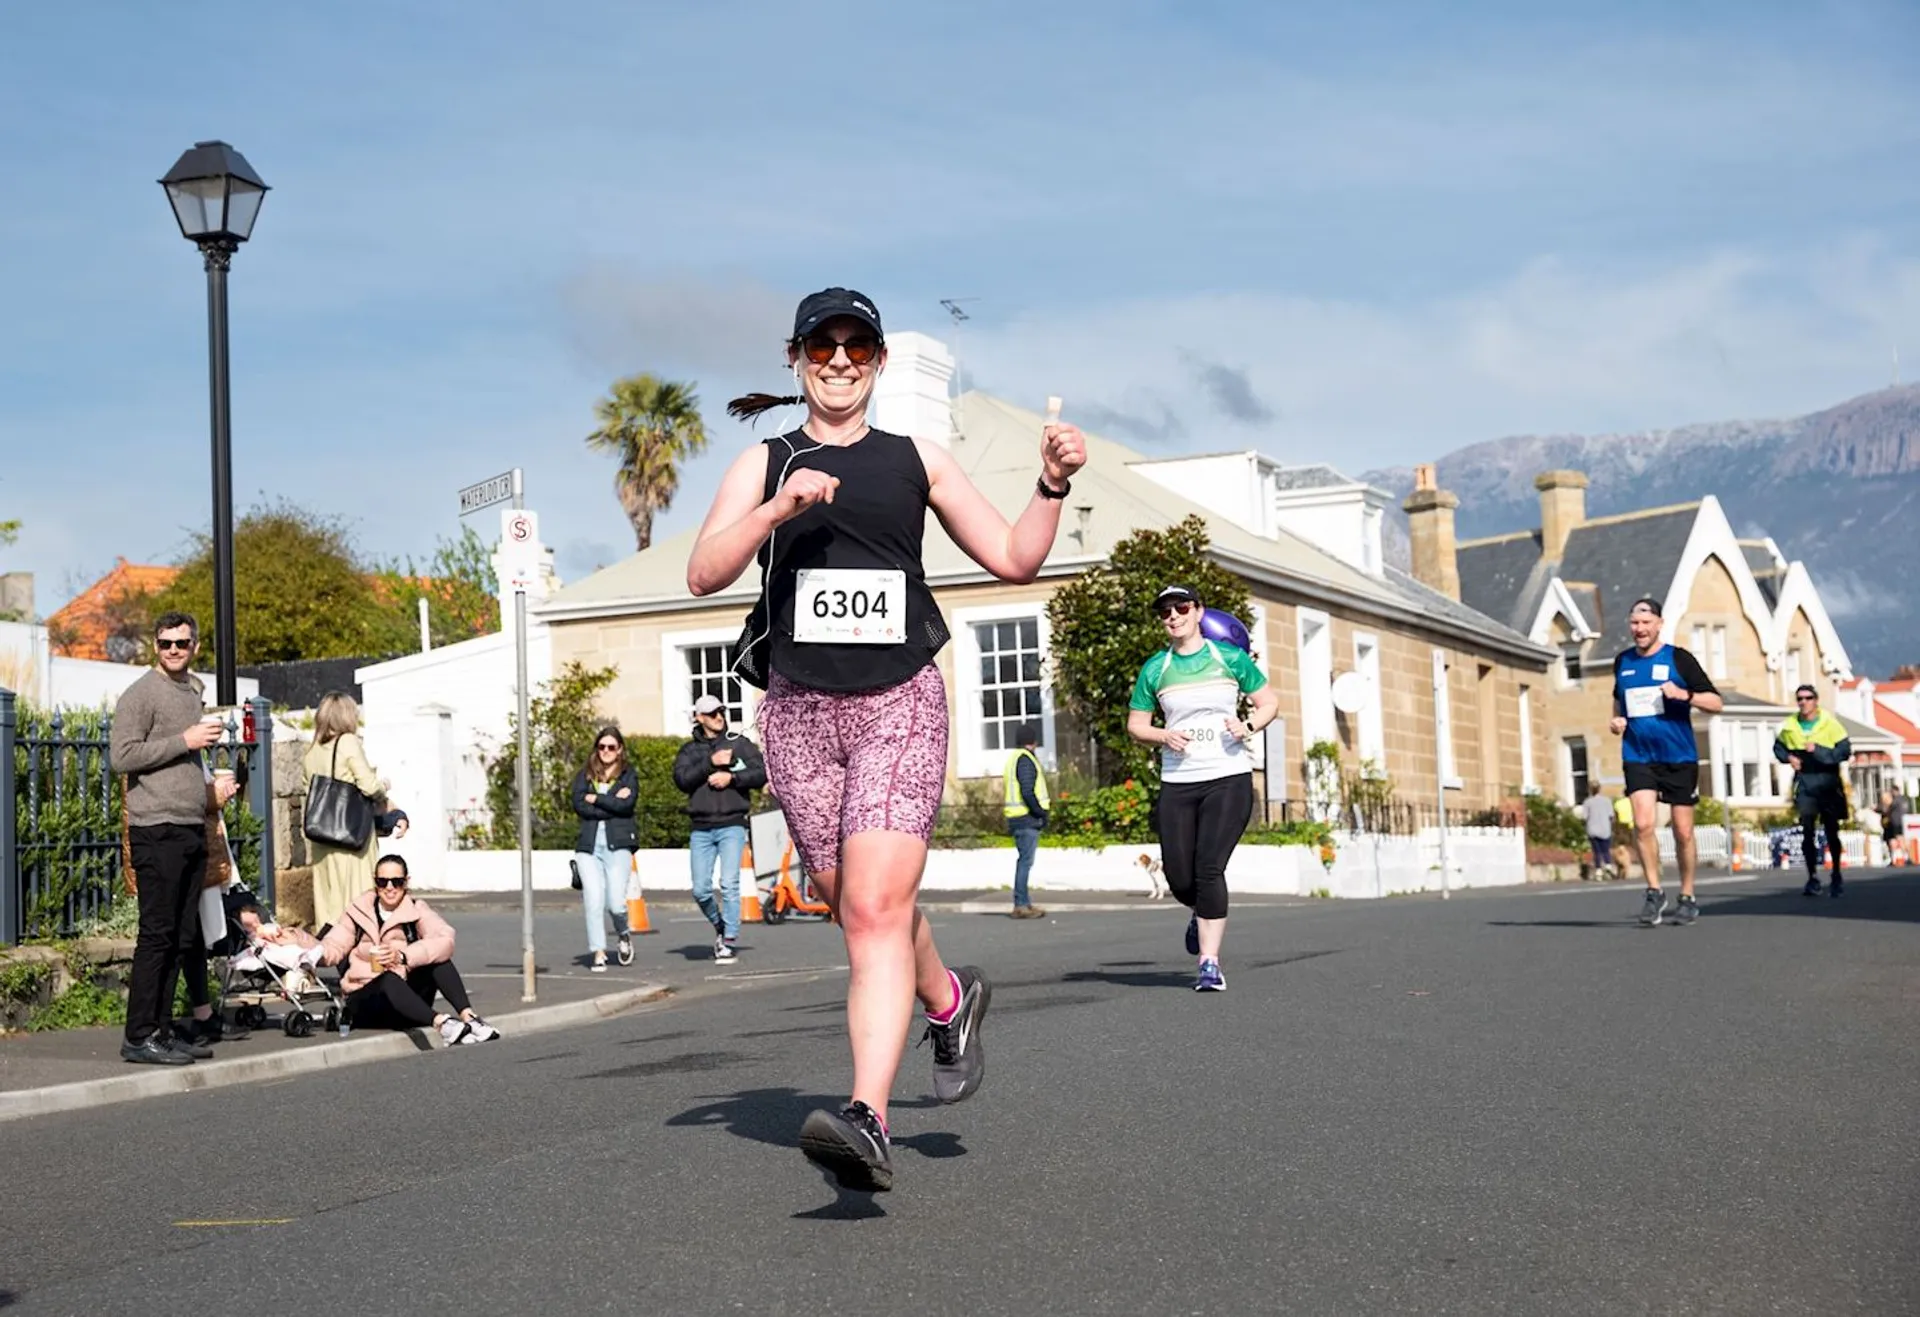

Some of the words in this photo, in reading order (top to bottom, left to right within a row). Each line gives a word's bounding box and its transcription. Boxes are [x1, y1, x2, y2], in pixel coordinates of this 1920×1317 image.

[460, 481, 498, 512] WATERLOO
[514, 521, 527, 539] S
[813, 590, 888, 619] 6304
[1183, 728, 1215, 742] 280
